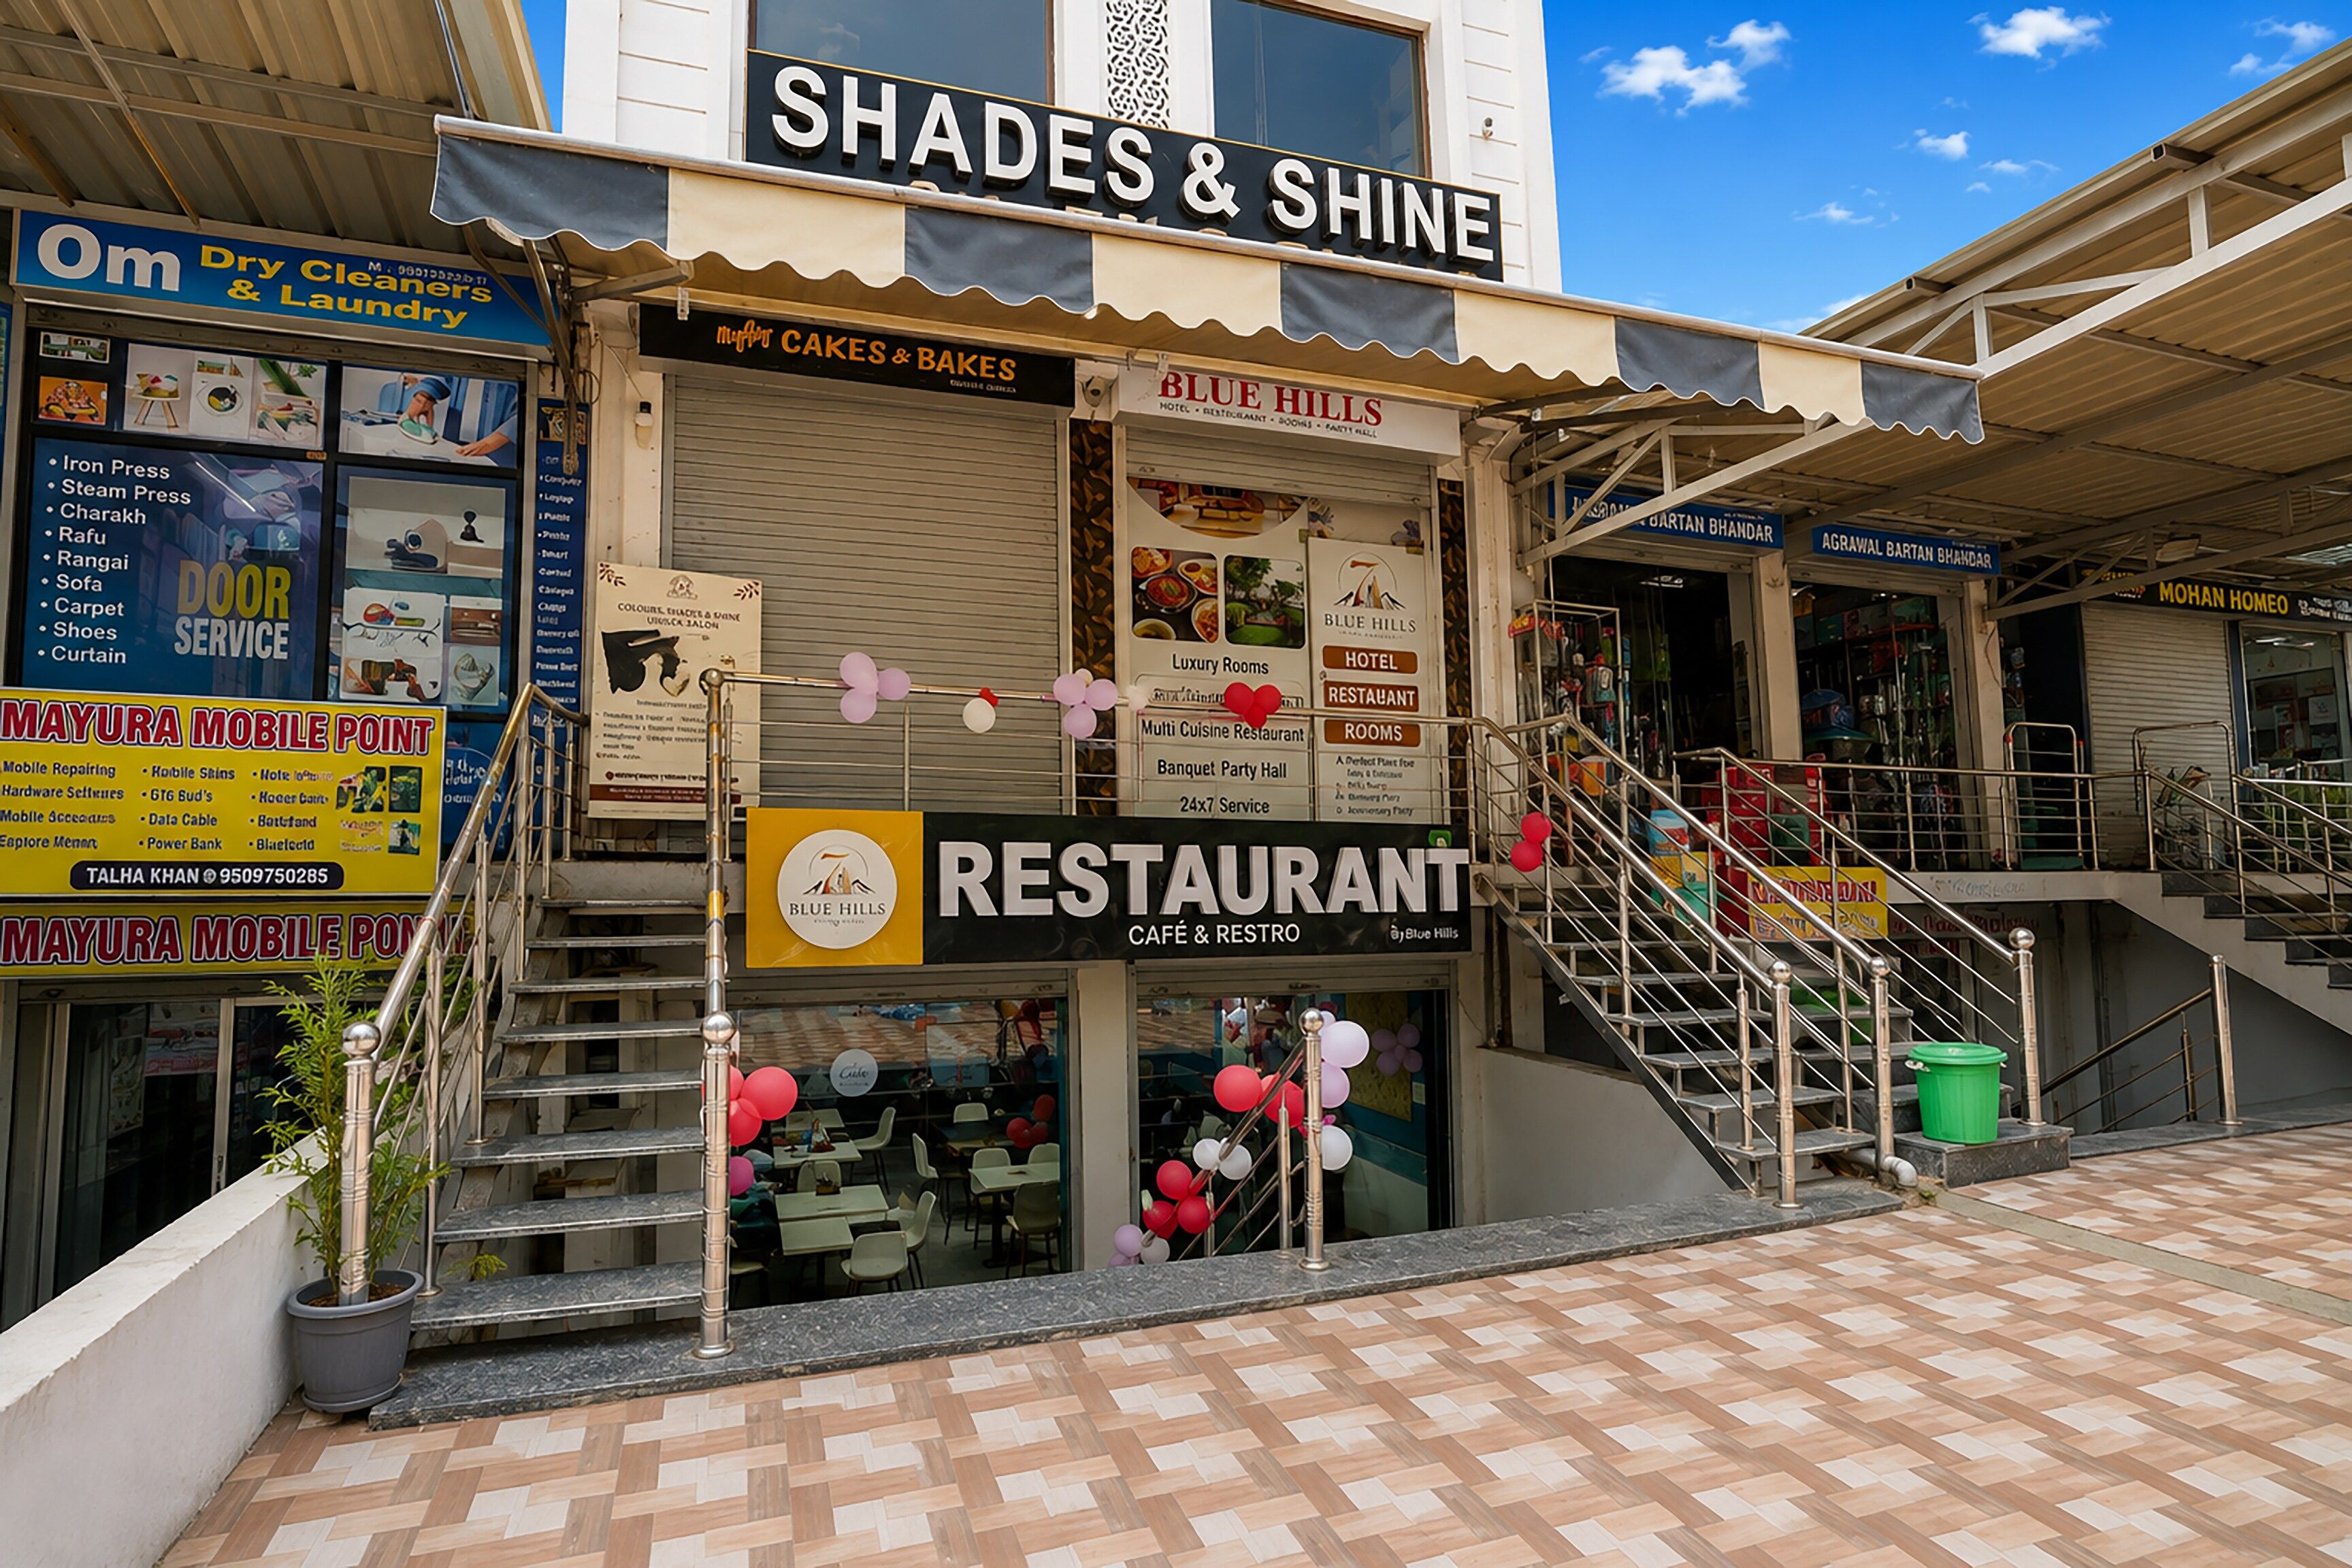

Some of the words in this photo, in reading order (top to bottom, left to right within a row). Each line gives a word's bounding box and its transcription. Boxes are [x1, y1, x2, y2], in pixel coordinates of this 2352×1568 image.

[771, 65, 1154, 204] SHADES
[1181, 142, 1241, 219] &
[1269, 159, 1494, 263] SHINE
[37, 223, 180, 291] Om
[201, 245, 285, 279] Dry
[300, 259, 493, 303] Cleaners
[227, 279, 261, 301] &
[280, 284, 468, 329] Laundry
[781, 329, 887, 365] CAKES
[892, 348, 912, 364] &
[917, 347, 1017, 381] BAKES
[1158, 371, 1262, 410] BLUE
[1274, 385, 1382, 427] HILLS
[1160, 402, 1190, 413] HOTEL
[63, 455, 104, 475] Iron
[112, 459, 170, 480] Press
[61, 479, 127, 500] Steam
[134, 485, 191, 505] Press
[60, 502, 146, 525] Charakh
[59, 525, 106, 546] Rafu
[1709, 517, 1774, 542] BHANDAR
[1822, 532, 1883, 556] AGRAWAL
[1886, 541, 1933, 561] BARTAN
[57, 549, 129, 573] Rangai
[56, 574, 103, 592] Sofa
[177, 559, 291, 619] DOOR
[54, 597, 125, 619] Carpet
[2159, 581, 2225, 608] MOHAN
[2230, 589, 2289, 615] HOMEO
[53, 621, 117, 640] Shoes
[1324, 613, 1365, 629] BLUE
[1372, 617, 1416, 634] HILLS
[174, 616, 289, 660] SERVICE
[52, 645, 127, 664] Curtain
[1172, 653, 1218, 675] Luxury
[1223, 657, 1269, 674] Rooms
[1345, 651, 1399, 670] HOTEL
[0, 700, 182, 747] MAYURA
[190, 706, 329, 751] MOBILE
[335, 713, 435, 755] POINT
[1141, 719, 1175, 737] Multi
[1179, 720, 1230, 738] Cuisine
[1234, 723, 1305, 742] Restaurant
[1345, 723, 1403, 742] ROOMS
[3, 761, 48, 774] Mobile
[52, 762, 116, 779] Repairing
[1157, 759, 1215, 779] Banquet
[1221, 760, 1258, 781] Party
[1261, 762, 1287, 779] Hall
[2, 785, 63, 798] Hardware
[0, 809, 44, 823] Mobile
[1179, 796, 1215, 813] 24x7
[1220, 796, 1270, 814] Service
[149, 813, 178, 826] Data
[182, 813, 218, 826] Cable
[147, 837, 187, 849] Power
[191, 837, 223, 850] Bank
[86, 868, 145, 884] TALHA
[150, 868, 199, 884] KHAN
[219, 868, 329, 884] 9509750285
[938, 841, 1470, 917] RESTAURANT
[789, 902, 832, 916] BLUE
[840, 902, 886, 916] HILLS
[0, 915, 183, 965] MAYURA
[191, 914, 342, 964] MOBILE
[1128, 919, 1188, 946] CAFÉ
[1194, 924, 1210, 945] &
[1216, 923, 1301, 944] RESTRO
[1405, 928, 1431, 939] Blue
[1434, 927, 1459, 939] Hills
